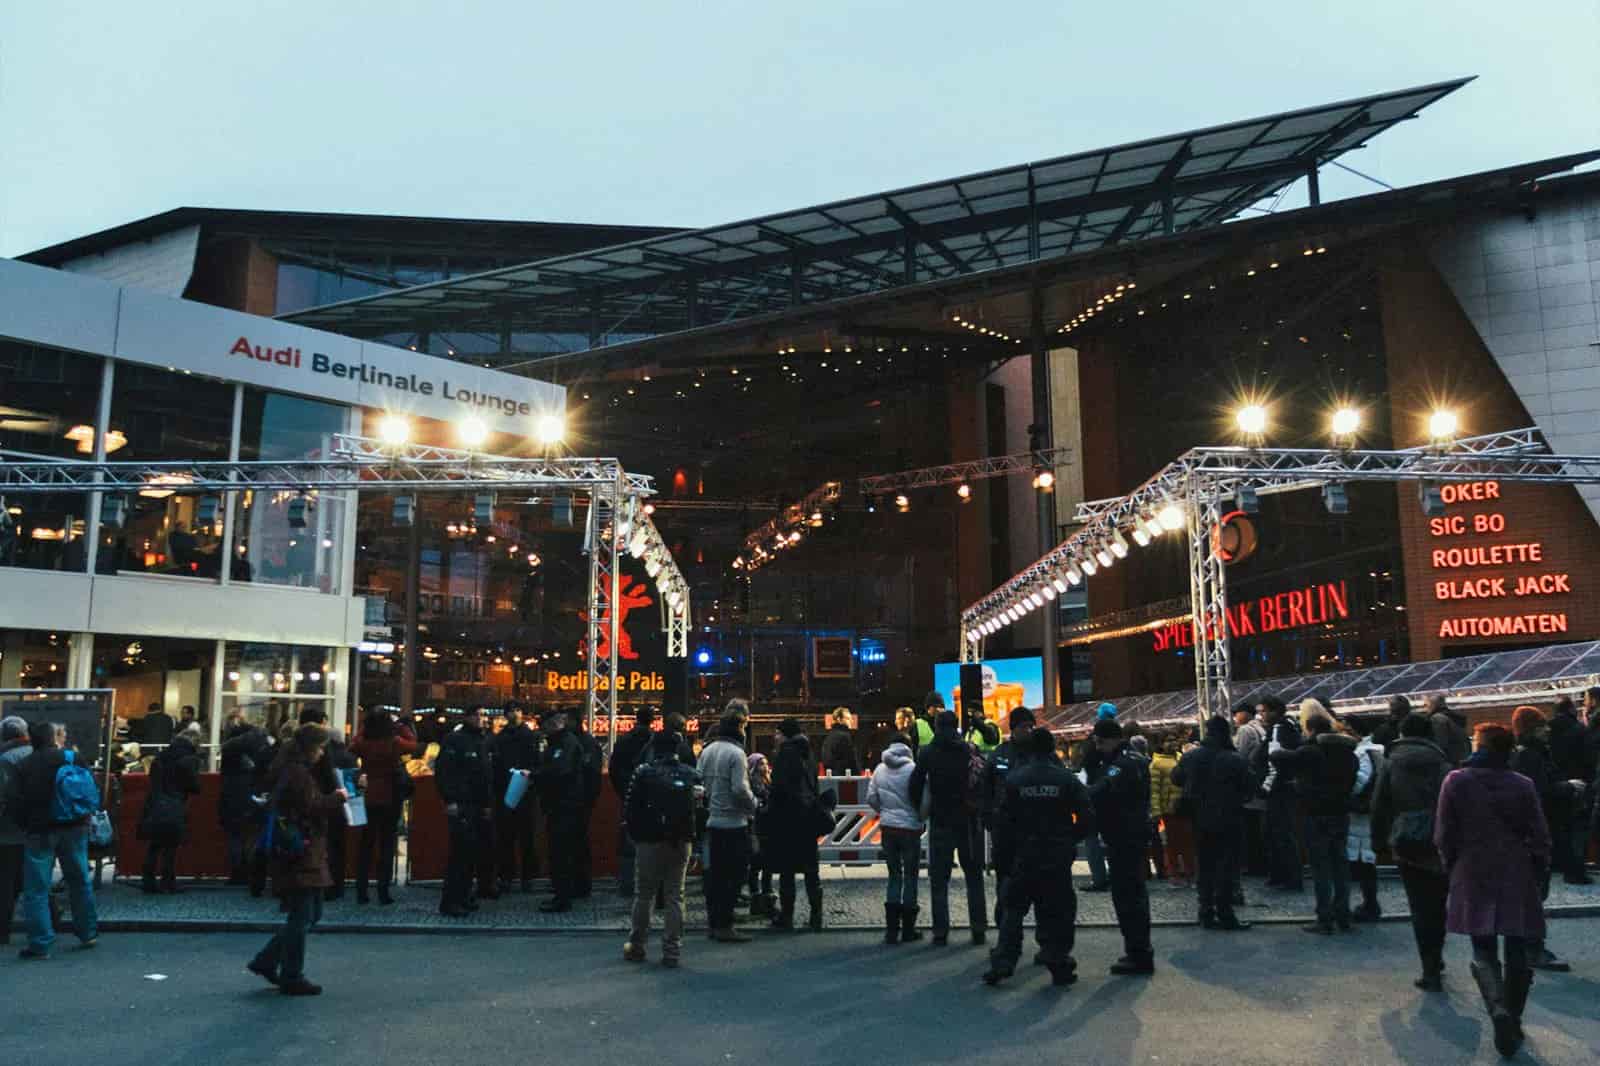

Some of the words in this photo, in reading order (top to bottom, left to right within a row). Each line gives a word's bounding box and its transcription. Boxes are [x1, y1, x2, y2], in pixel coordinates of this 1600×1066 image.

[229, 336, 301, 369] Audi
[311, 353, 434, 396] Berlinale
[442, 381, 531, 416] Lounge
[1440, 481, 1500, 503] OKER
[1430, 515, 1465, 536] SIC
[1474, 513, 1505, 533] BO
[1432, 543, 1543, 568] ROULETTE
[1435, 578, 1506, 600] BLACK
[1514, 574, 1571, 596] JACK
[1259, 580, 1349, 633] BERLIN
[1439, 614, 1569, 638] AUTOMATEN
[547, 670, 626, 691] Berliae
[630, 671, 665, 691] Pala
